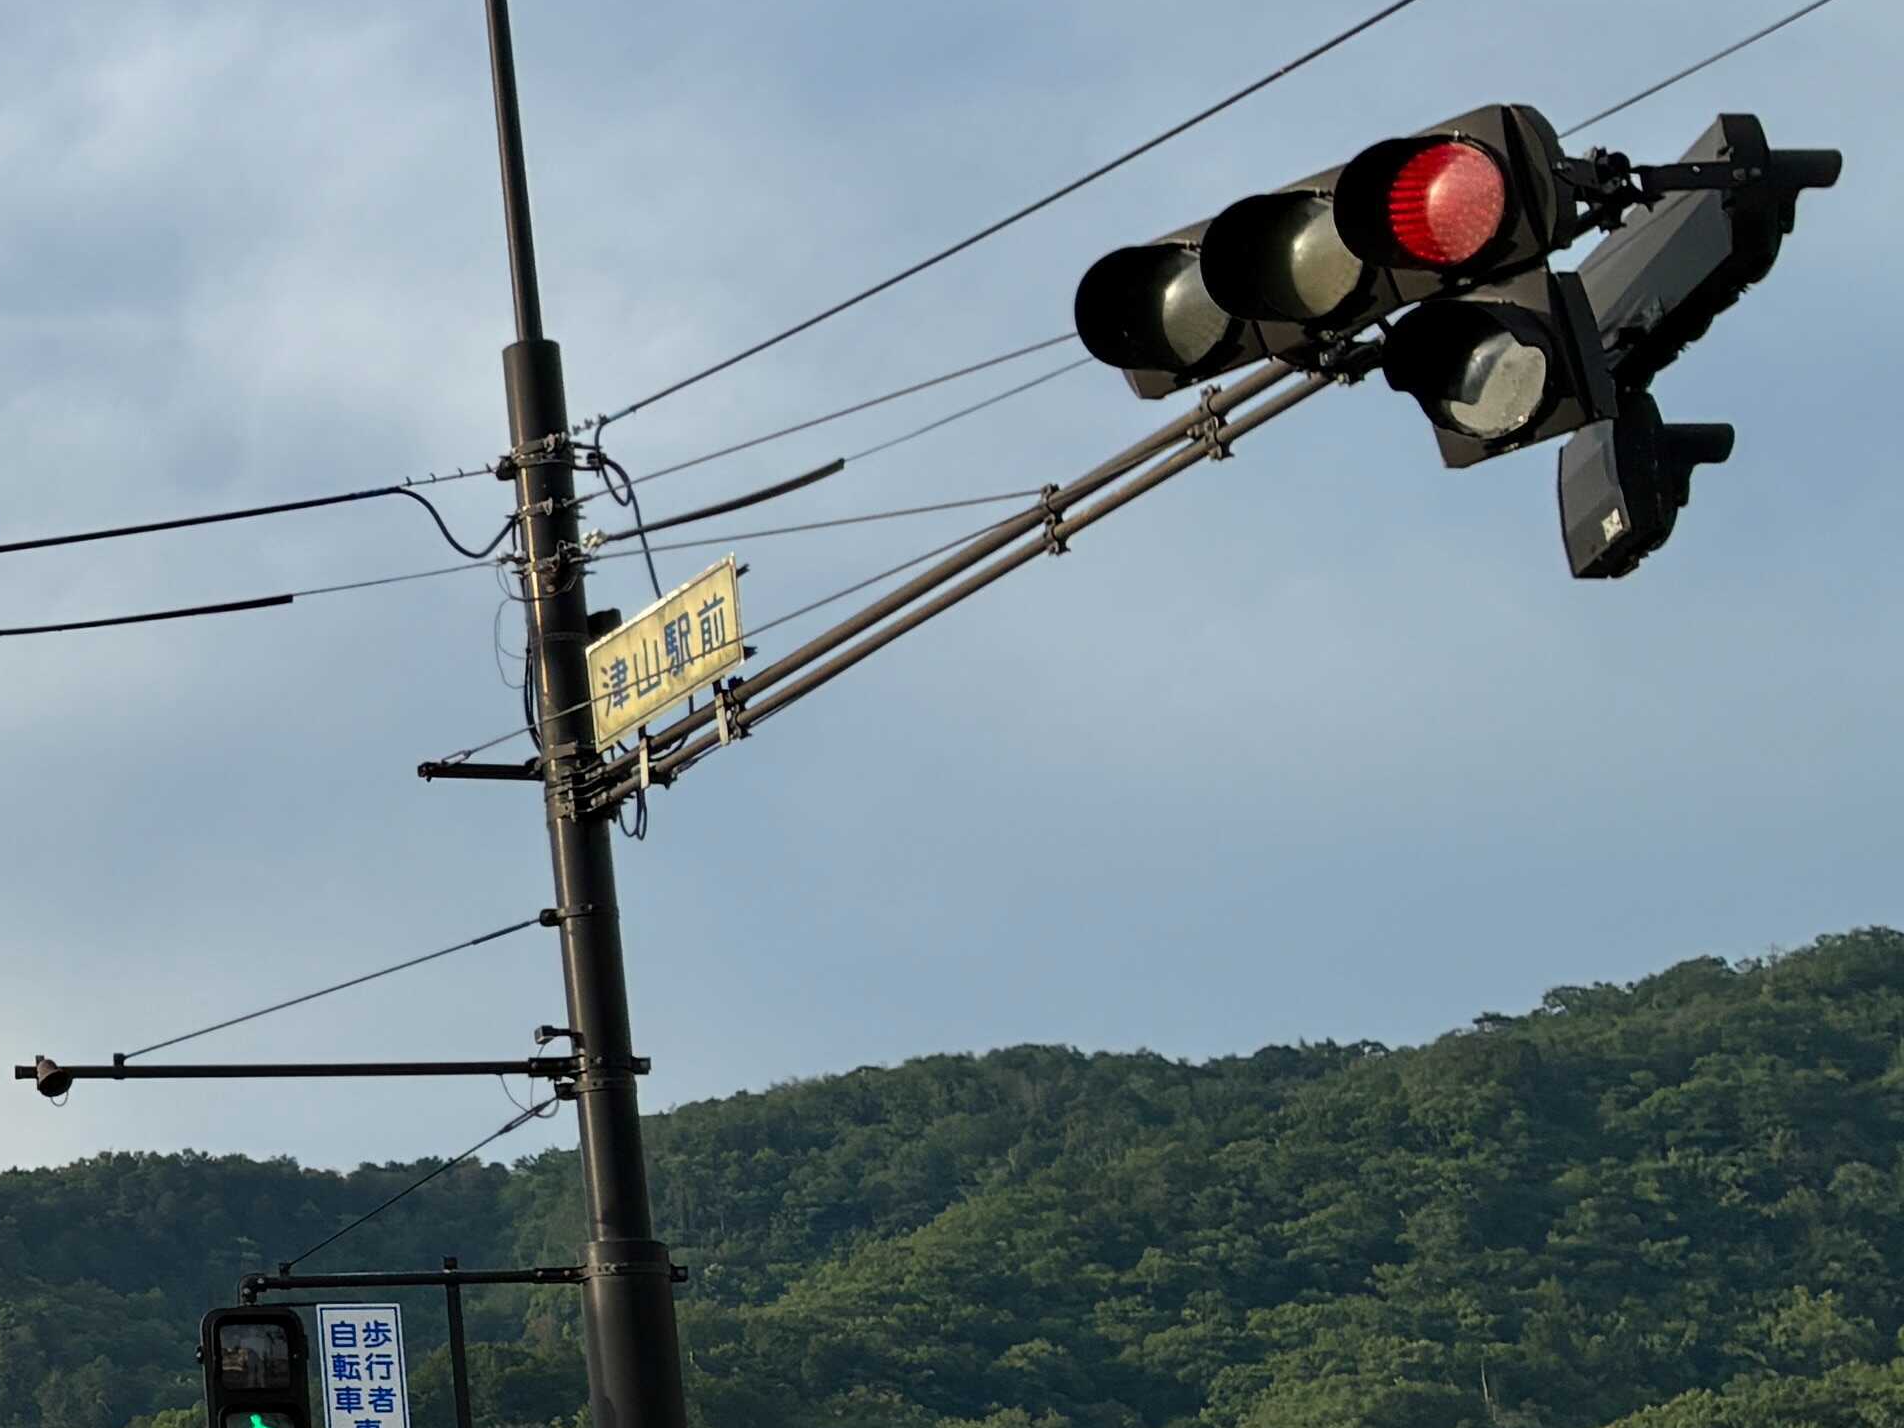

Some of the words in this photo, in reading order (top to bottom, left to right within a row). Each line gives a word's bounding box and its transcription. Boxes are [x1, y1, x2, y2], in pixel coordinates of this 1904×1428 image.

[600, 592, 725, 718] 津山駅前
[330, 1320, 364, 1415] 自転車
[362, 1319, 397, 1415] 歩行者
